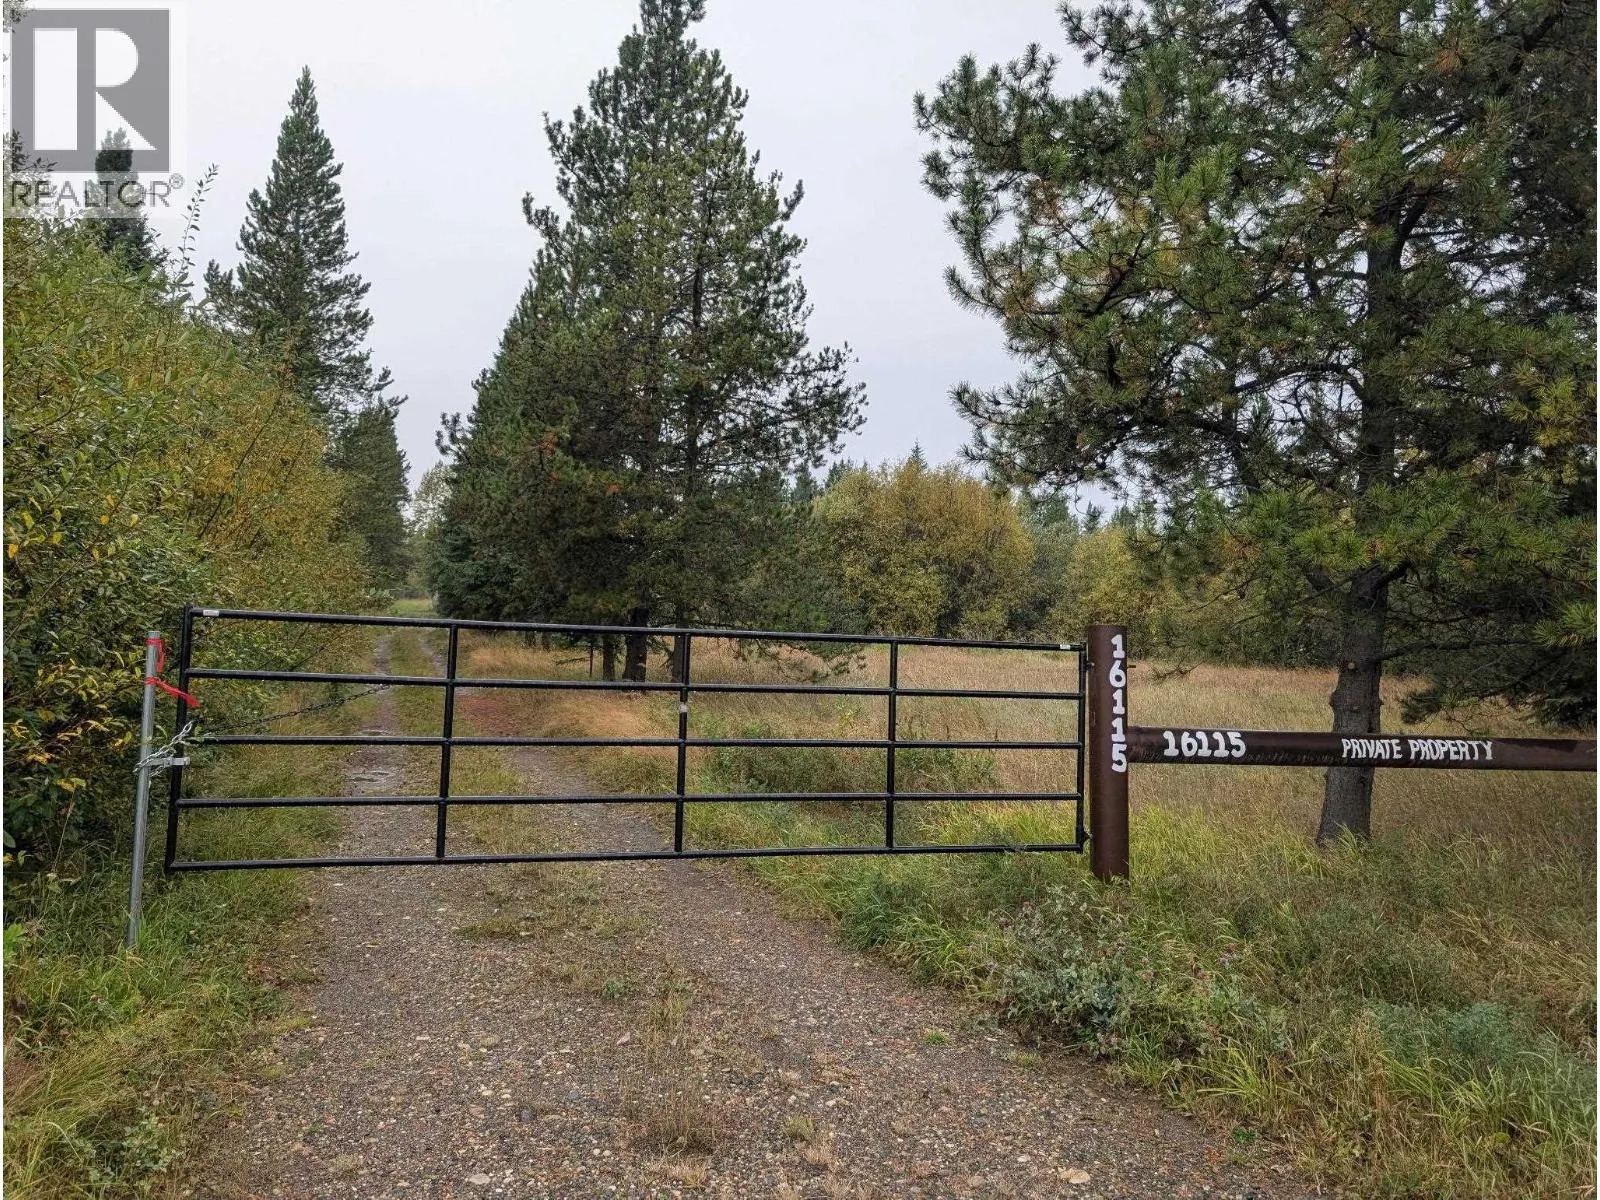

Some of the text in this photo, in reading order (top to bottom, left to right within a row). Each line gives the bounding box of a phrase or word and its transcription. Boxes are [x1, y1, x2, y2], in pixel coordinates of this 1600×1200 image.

[1109, 634, 1128, 773] 16115
[1162, 730, 1247, 758] 16115
[1341, 738, 1493, 761] PRIVATE PROPERTY
